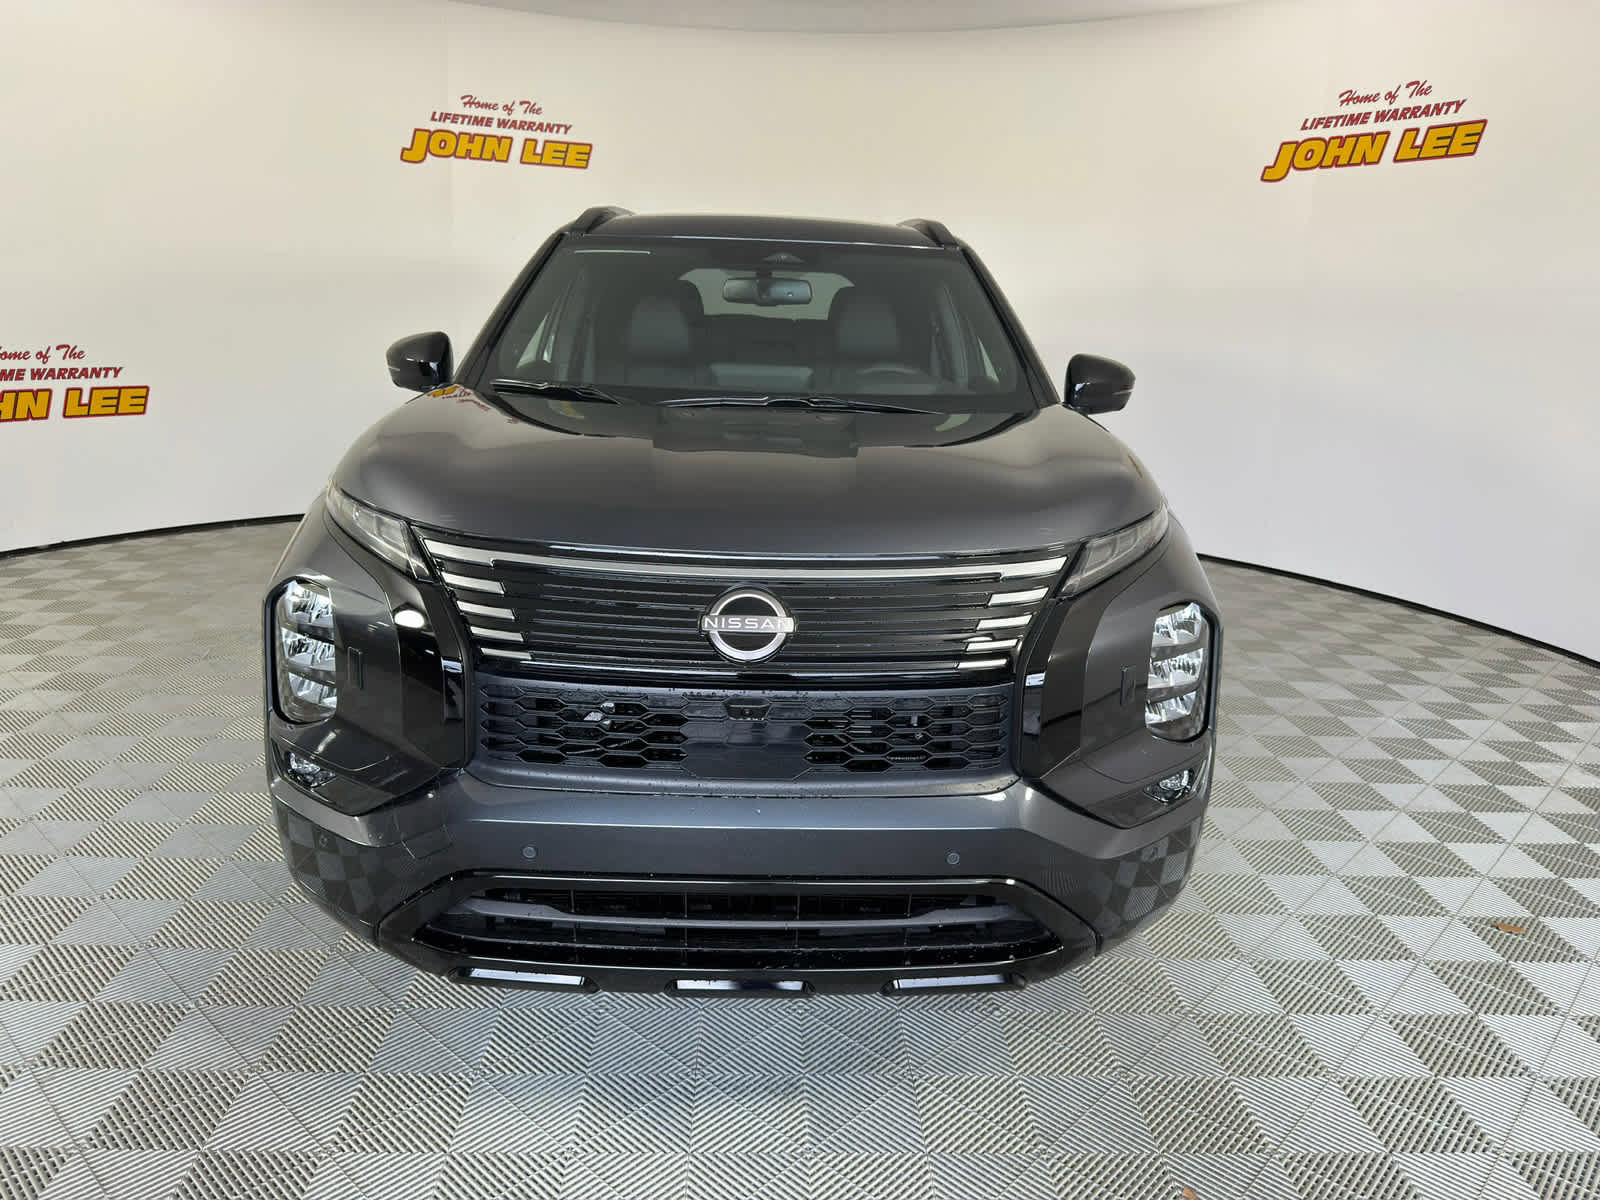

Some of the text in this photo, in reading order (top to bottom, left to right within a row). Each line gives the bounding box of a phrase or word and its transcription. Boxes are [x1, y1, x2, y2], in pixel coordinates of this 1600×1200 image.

[460, 94, 543, 115] Home of The
[1338, 80, 1433, 107] Home of The
[430, 111, 572, 134] LIFETIME WARRANTY
[1300, 99, 1467, 131] LIFETIME WARRANTY
[400, 128, 592, 169] JOHN LEE
[1260, 119, 1488, 183] JOHN LEE
[0, 344, 86, 364] ome of The
[30, 367, 124, 380] WARRANTY
[62, 385, 150, 418] LEE
[704, 617, 790, 630] NISSAN
